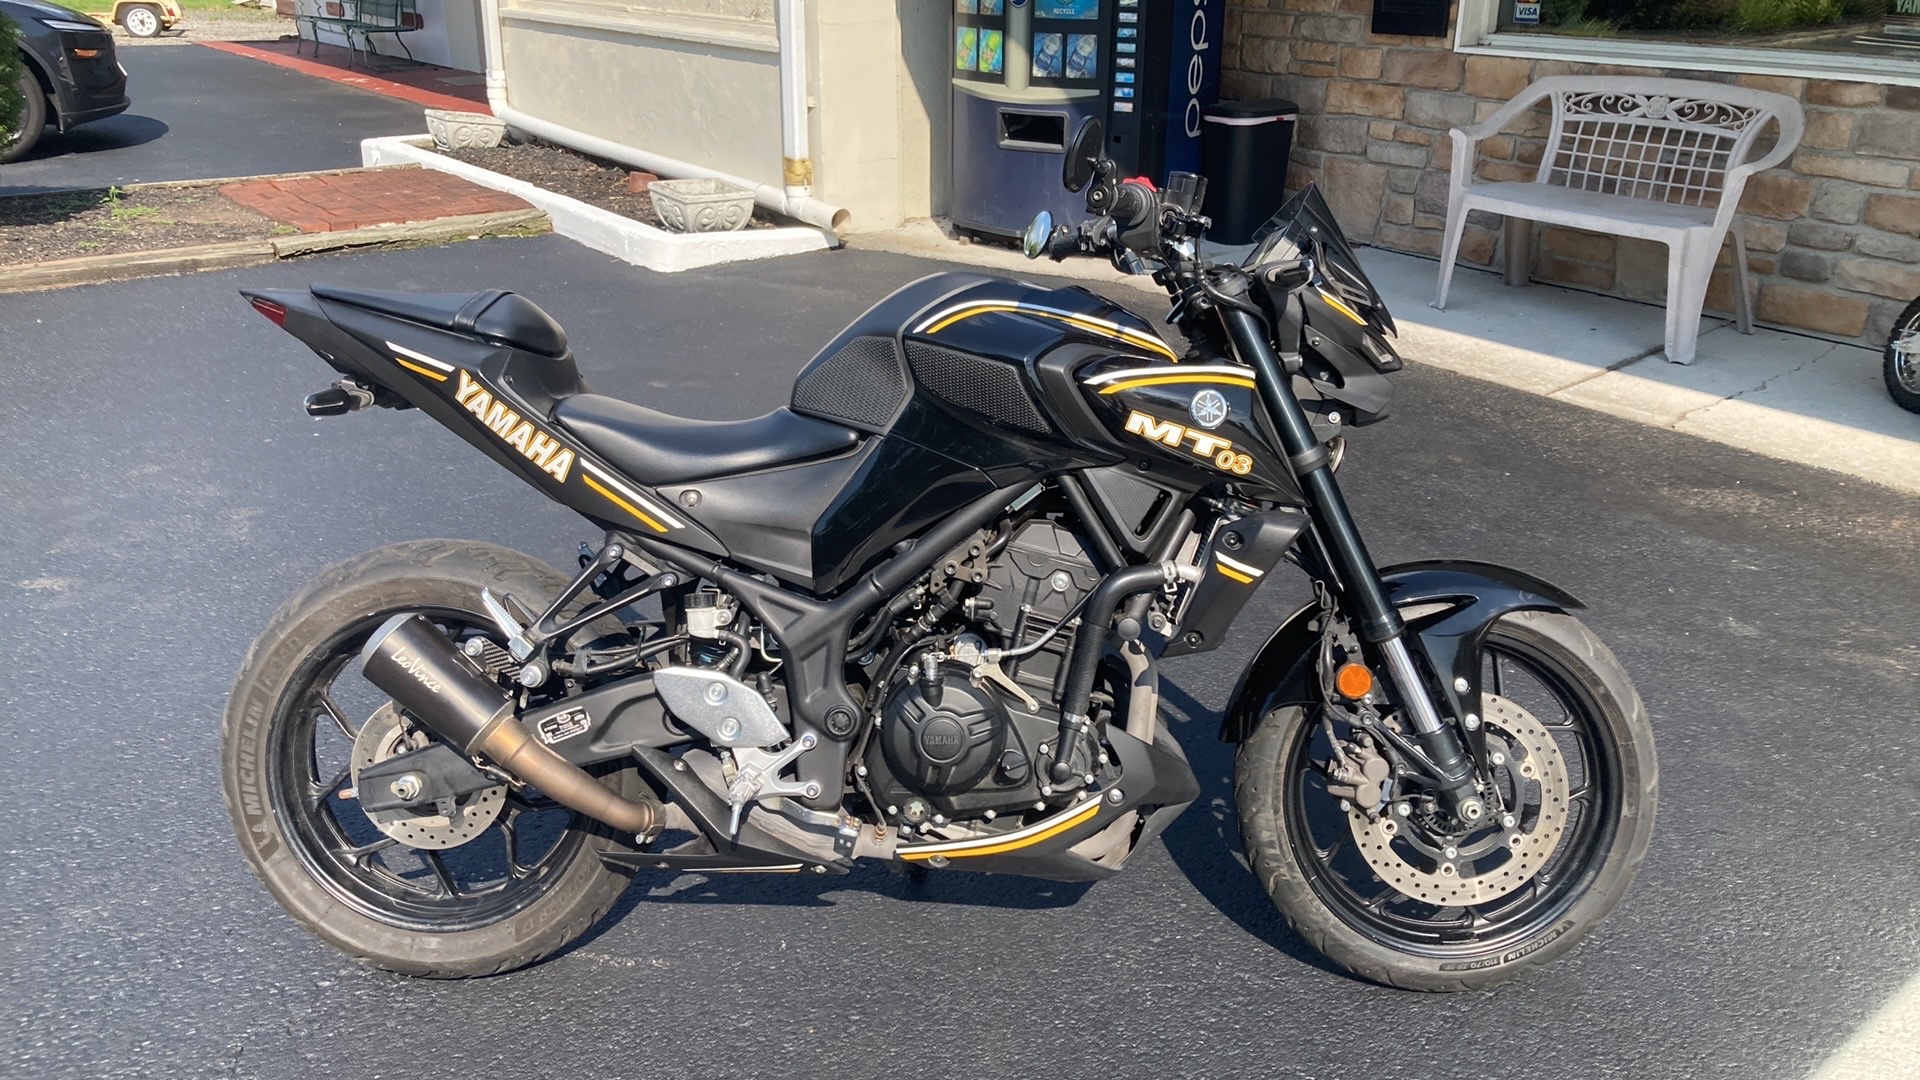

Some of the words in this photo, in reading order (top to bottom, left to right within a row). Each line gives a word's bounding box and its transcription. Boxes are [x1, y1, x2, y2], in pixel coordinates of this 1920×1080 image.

[1519, 6, 1538, 16] VISA
[1185, 0, 1209, 138] pep
[454, 369, 575, 484] YAMAHA
[391, 646, 441, 693] LeoVince
[239, 701, 264, 816] MICHELIN
[925, 735, 959, 745] YAMAHA
[1508, 931, 1557, 961] MICHELIN
